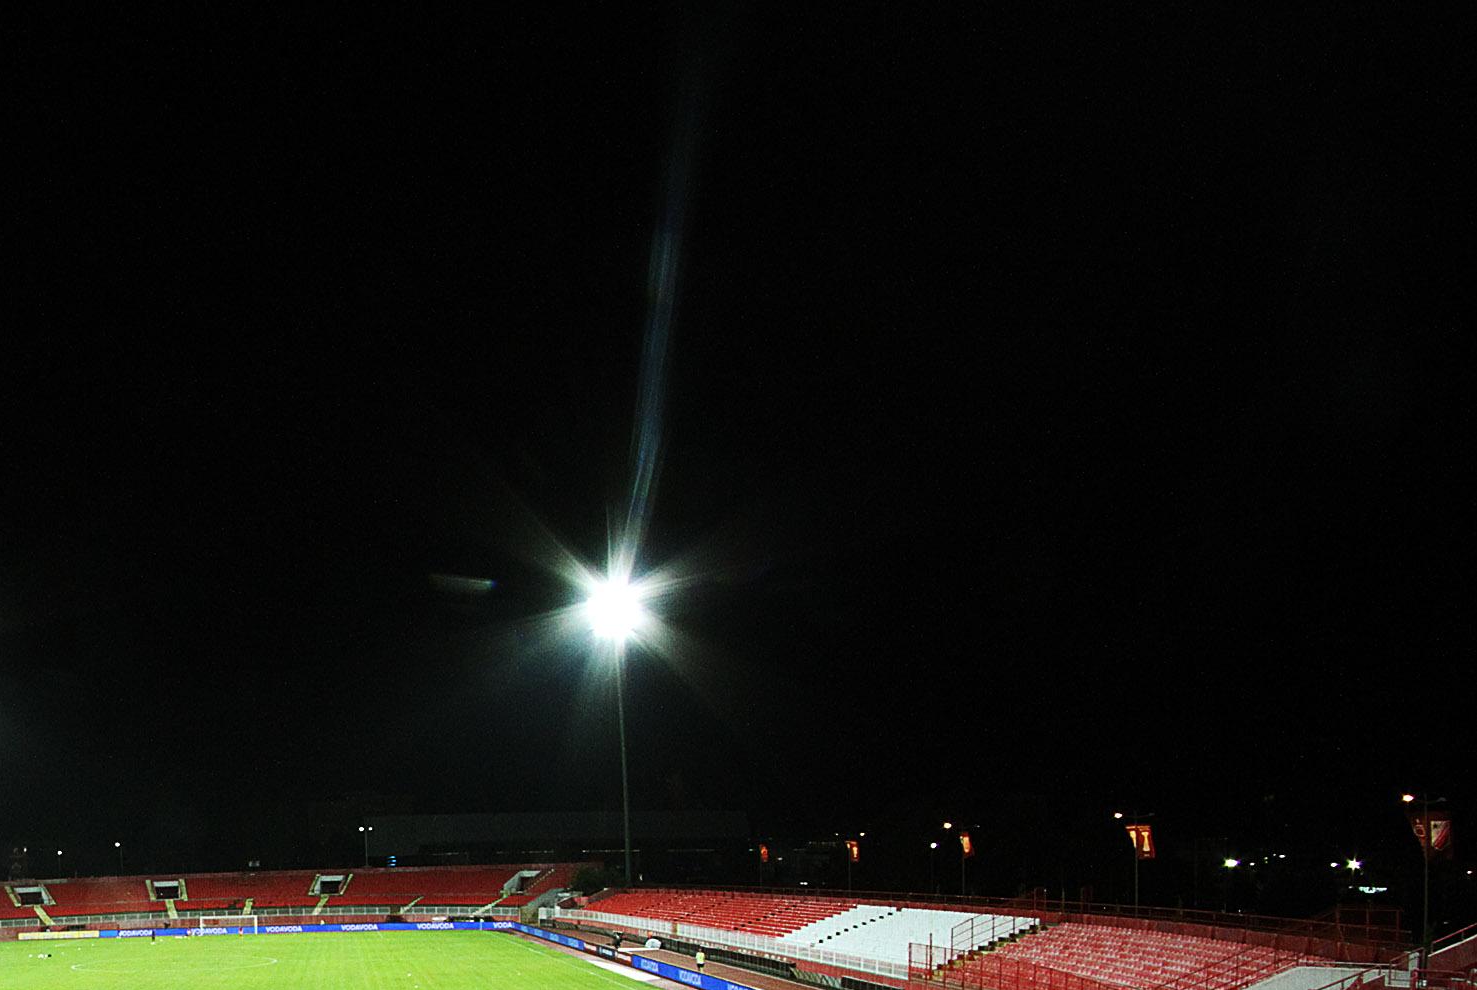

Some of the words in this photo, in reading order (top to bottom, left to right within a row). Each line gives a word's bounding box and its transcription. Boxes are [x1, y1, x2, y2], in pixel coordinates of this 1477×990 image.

[265, 925, 303, 933] VODAVODA
[340, 923, 379, 931] VODAVODA
[416, 922, 455, 930] VODAVODA
